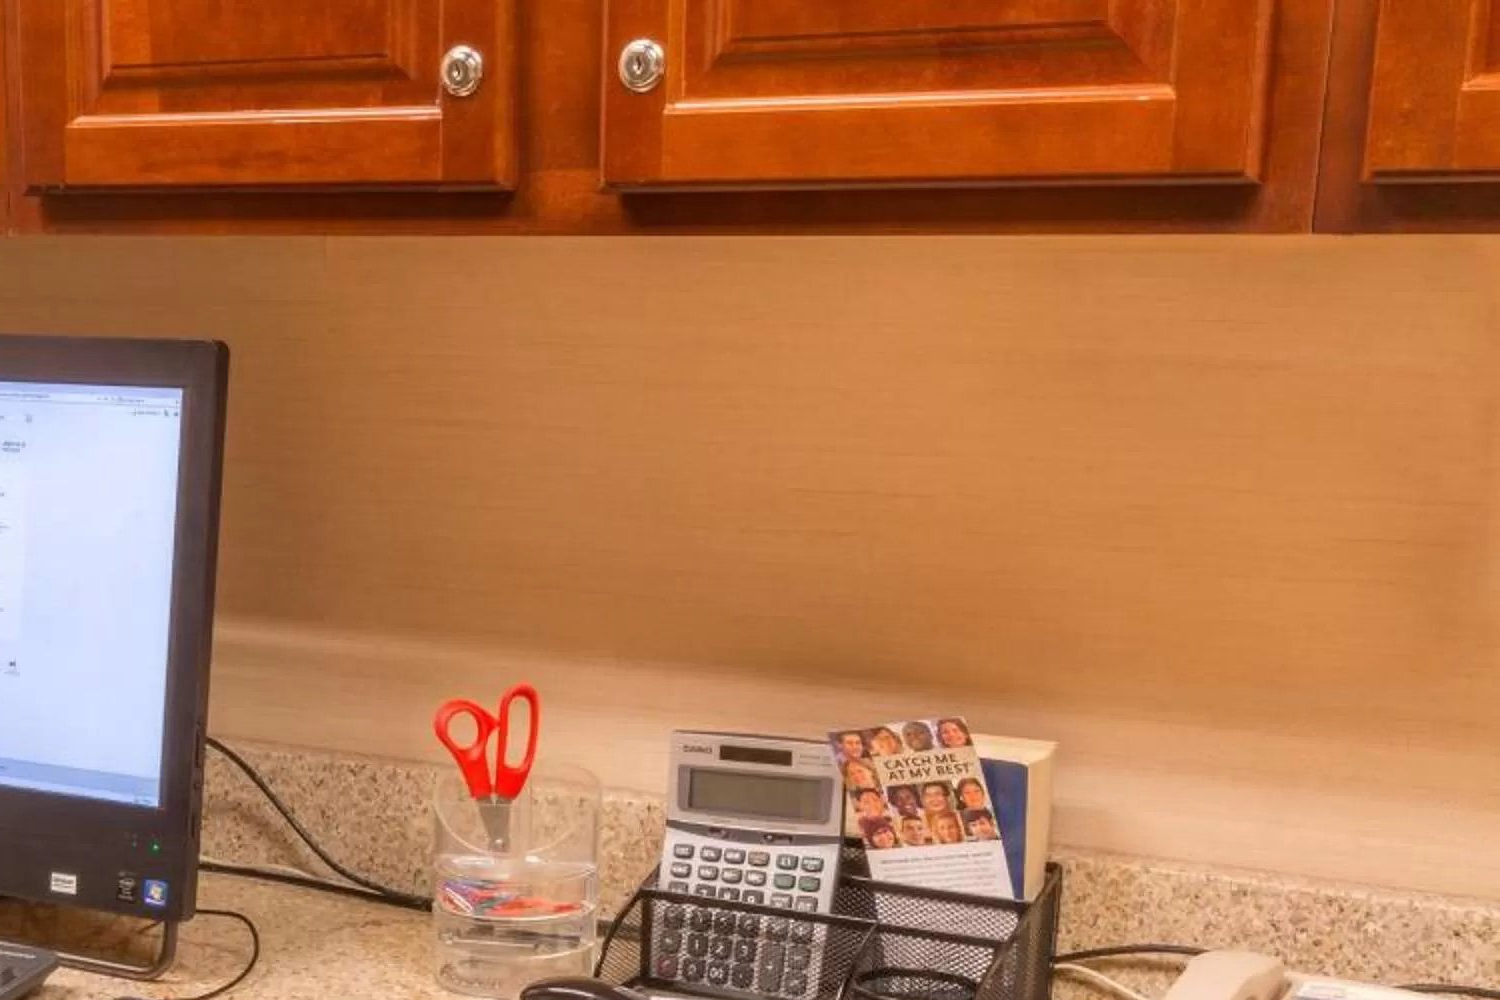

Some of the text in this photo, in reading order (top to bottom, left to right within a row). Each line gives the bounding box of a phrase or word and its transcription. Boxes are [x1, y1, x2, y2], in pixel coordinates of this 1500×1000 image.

[884, 754, 956, 769] CATCH ME
[889, 763, 969, 780] AT MY BEST
